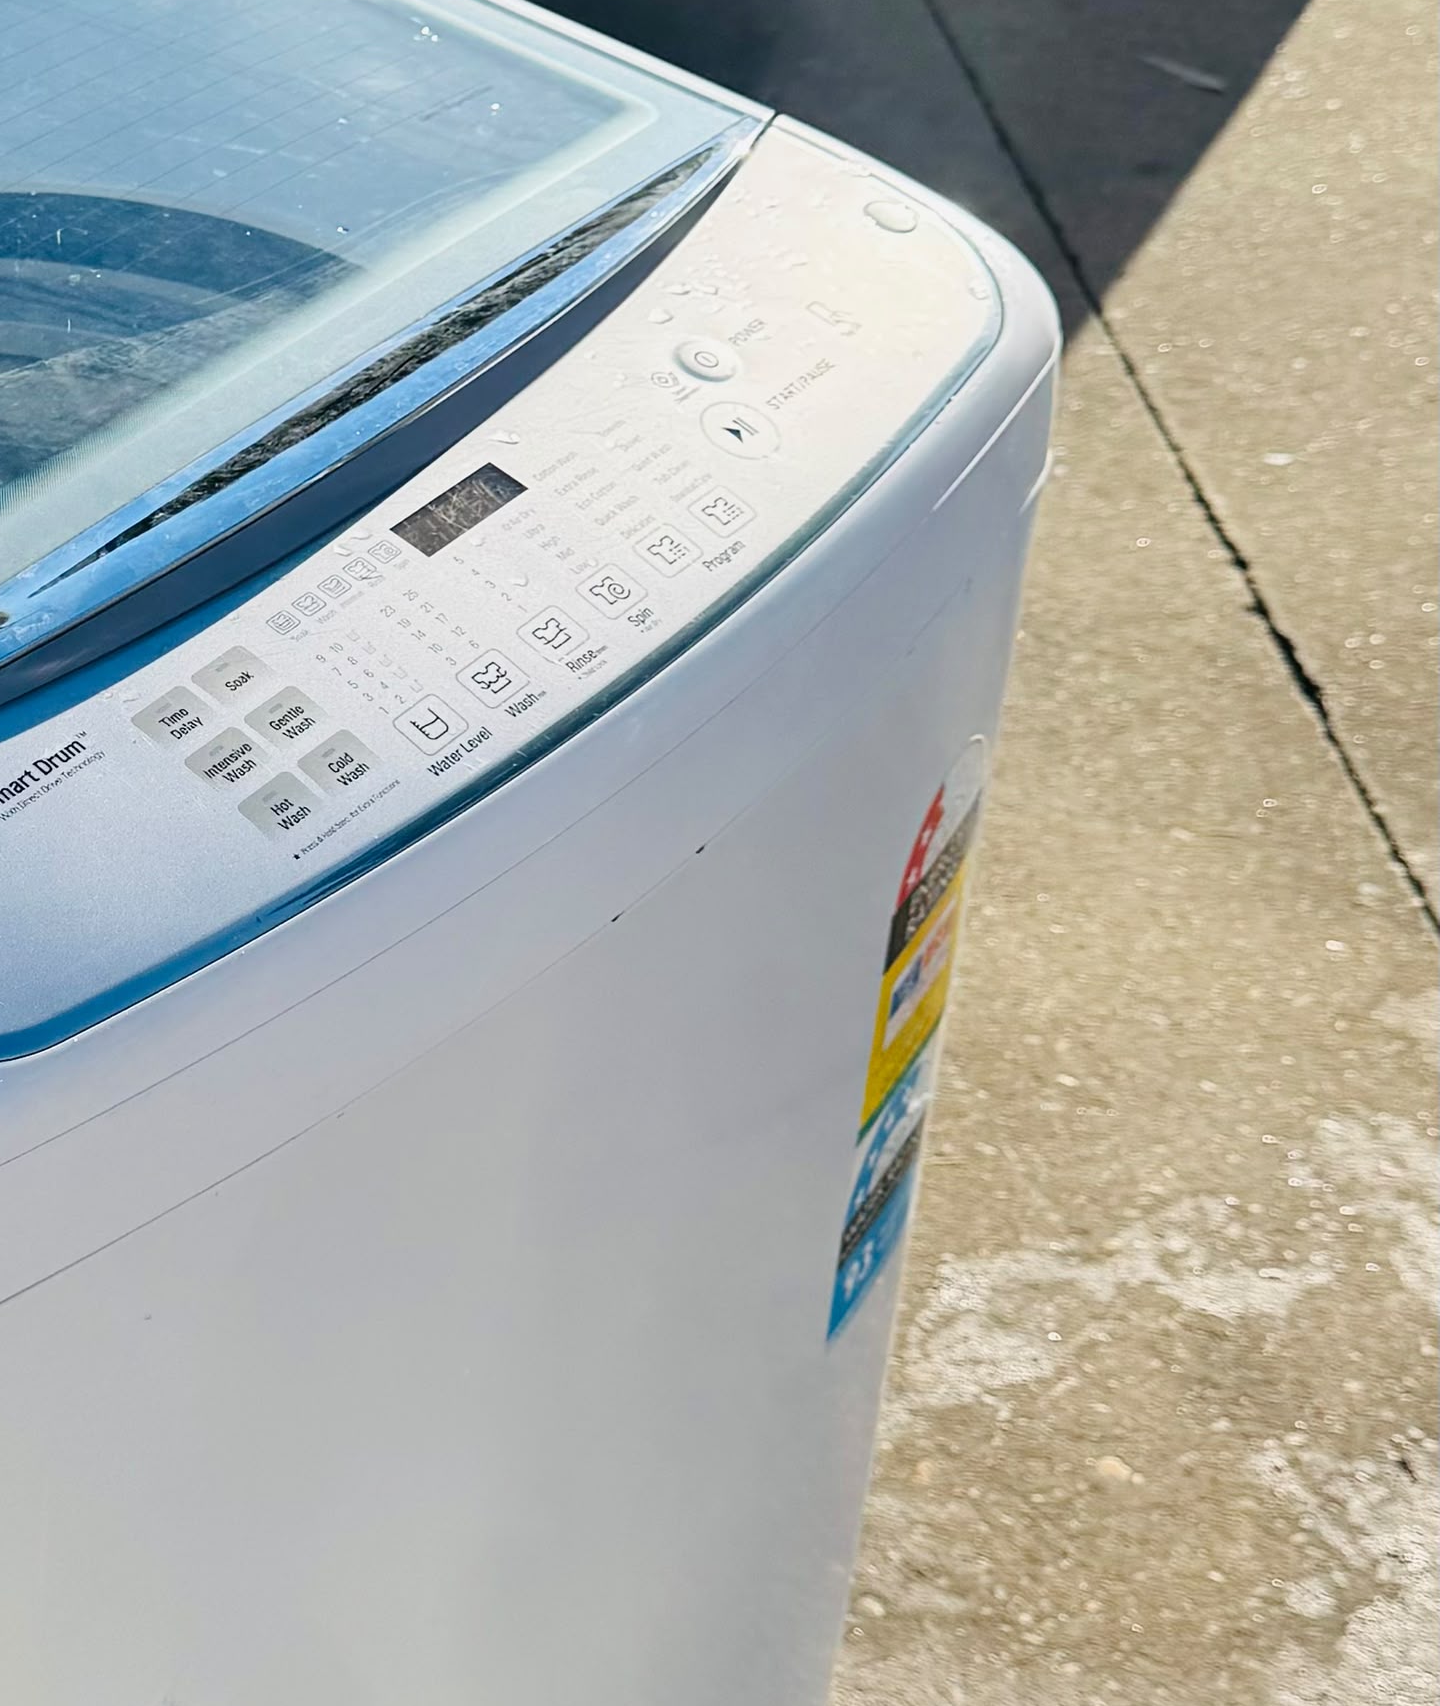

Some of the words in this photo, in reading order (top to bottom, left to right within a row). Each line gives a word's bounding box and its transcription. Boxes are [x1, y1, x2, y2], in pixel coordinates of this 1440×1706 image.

[727, 318, 766, 346] POWER
[701, 540, 746, 572] Program
[380, 605, 396, 618] 23
[627, 606, 655, 628] Spin
[397, 618, 411, 628] 19
[411, 630, 426, 640] 14
[329, 642, 344, 653] 10
[428, 643, 443, 653] 10
[331, 667, 342, 676] 7
[445, 657, 457, 666] 3
[565, 648, 598, 674] Rinse
[225, 670, 254, 692] Soak
[347, 680, 359, 689] 5
[363, 669, 374, 678] 6
[363, 693, 374, 702] 3
[395, 694, 406, 704] 2
[504, 692, 540, 719] Wash
[158, 707, 190, 728] Time
[170, 716, 204, 741] Delay
[269, 704, 305, 731] Gentle
[282, 716, 317, 740] Wash
[203, 743, 253, 779] Intensive
[328, 752, 355, 774] Cold
[427, 749, 464, 778] Water
[460, 726, 493, 754] Level
[222, 757, 257, 783] Wash
[336, 762, 371, 787] Wash
[270, 798, 296, 817] Hot
[277, 804, 312, 831] Wash
